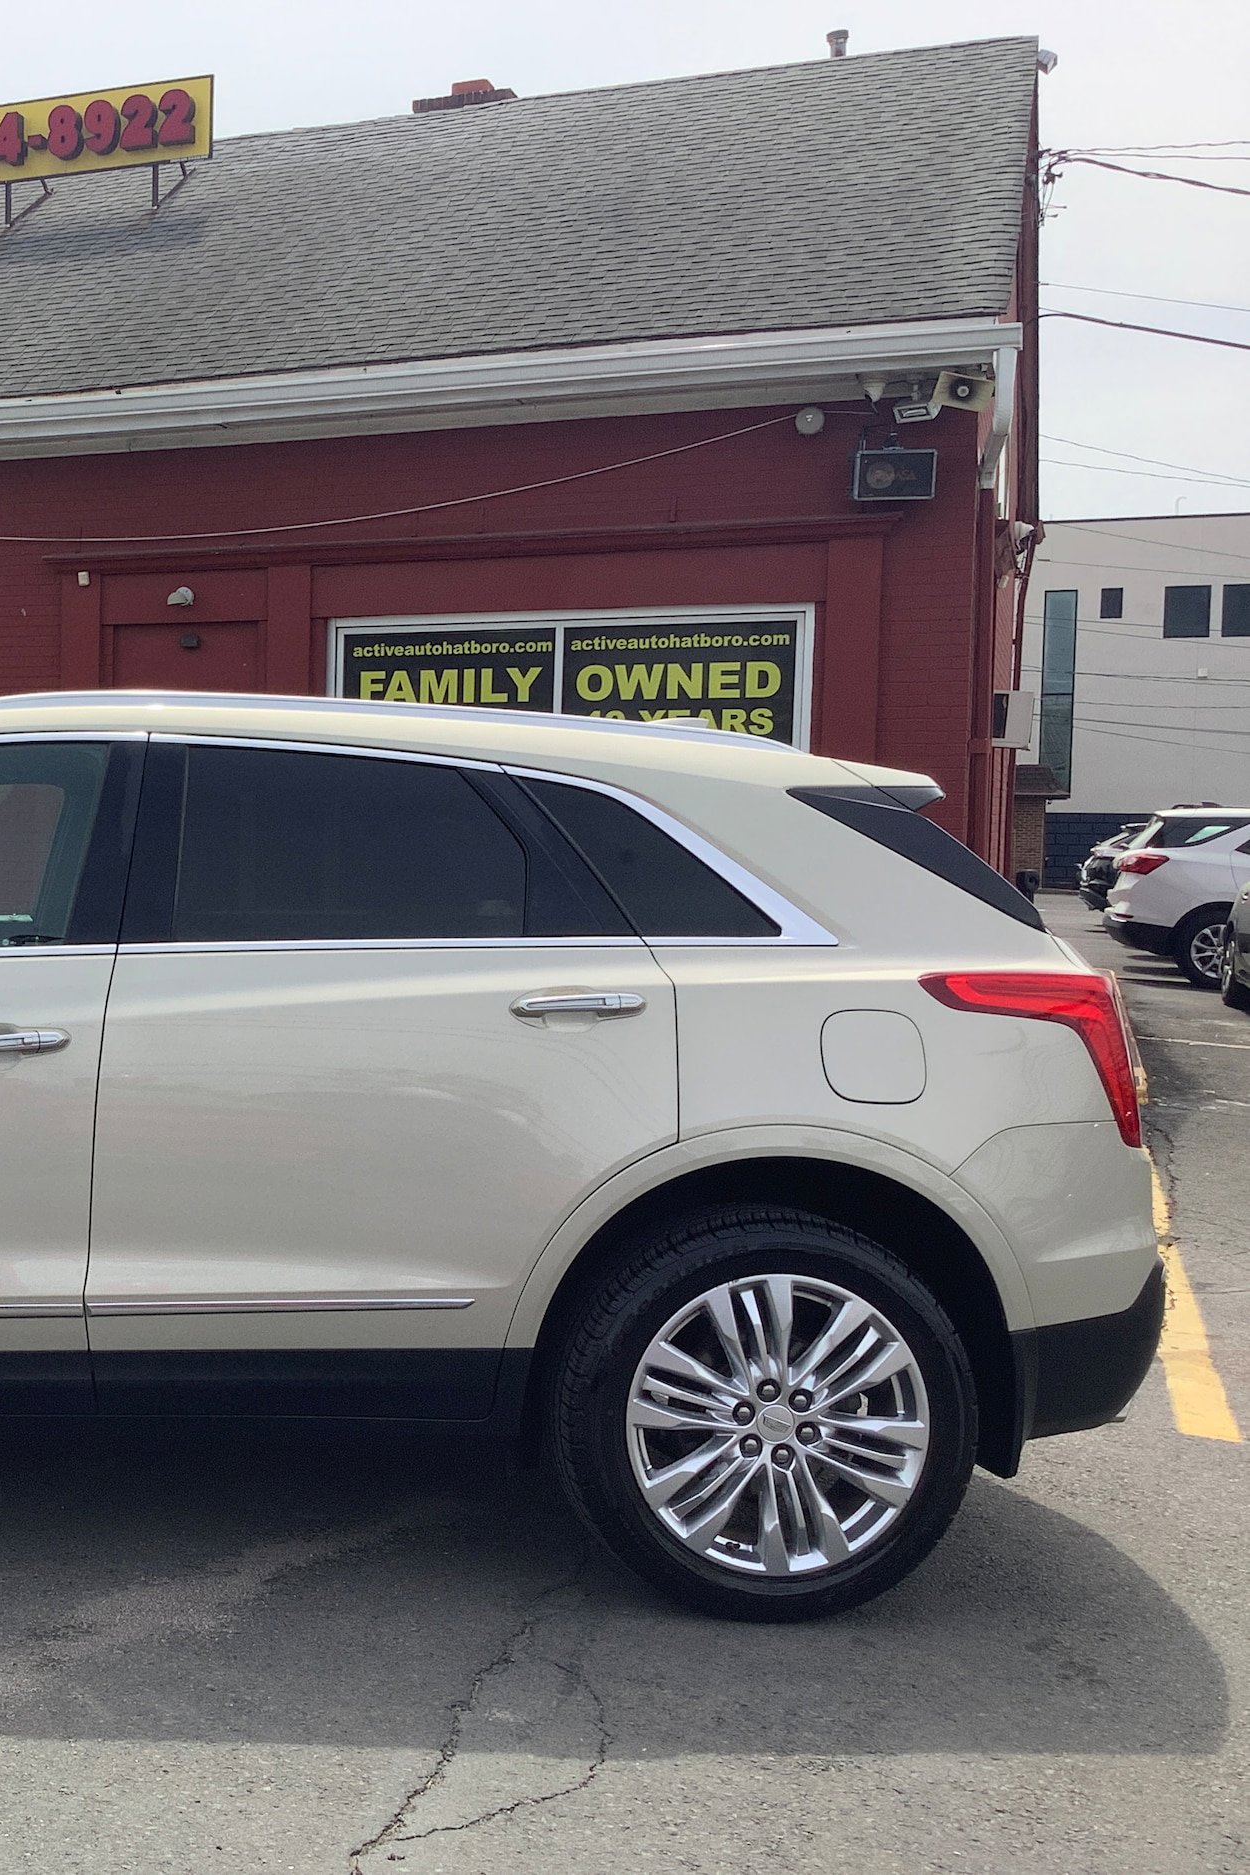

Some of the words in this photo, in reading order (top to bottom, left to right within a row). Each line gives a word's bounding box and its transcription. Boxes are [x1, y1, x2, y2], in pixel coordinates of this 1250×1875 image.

[352, 640, 553, 658] activeautohatboro.com
[570, 633, 791, 651] activeautohatboro.com
[359, 666, 544, 704] FAMILY
[575, 660, 782, 701] OWNED
